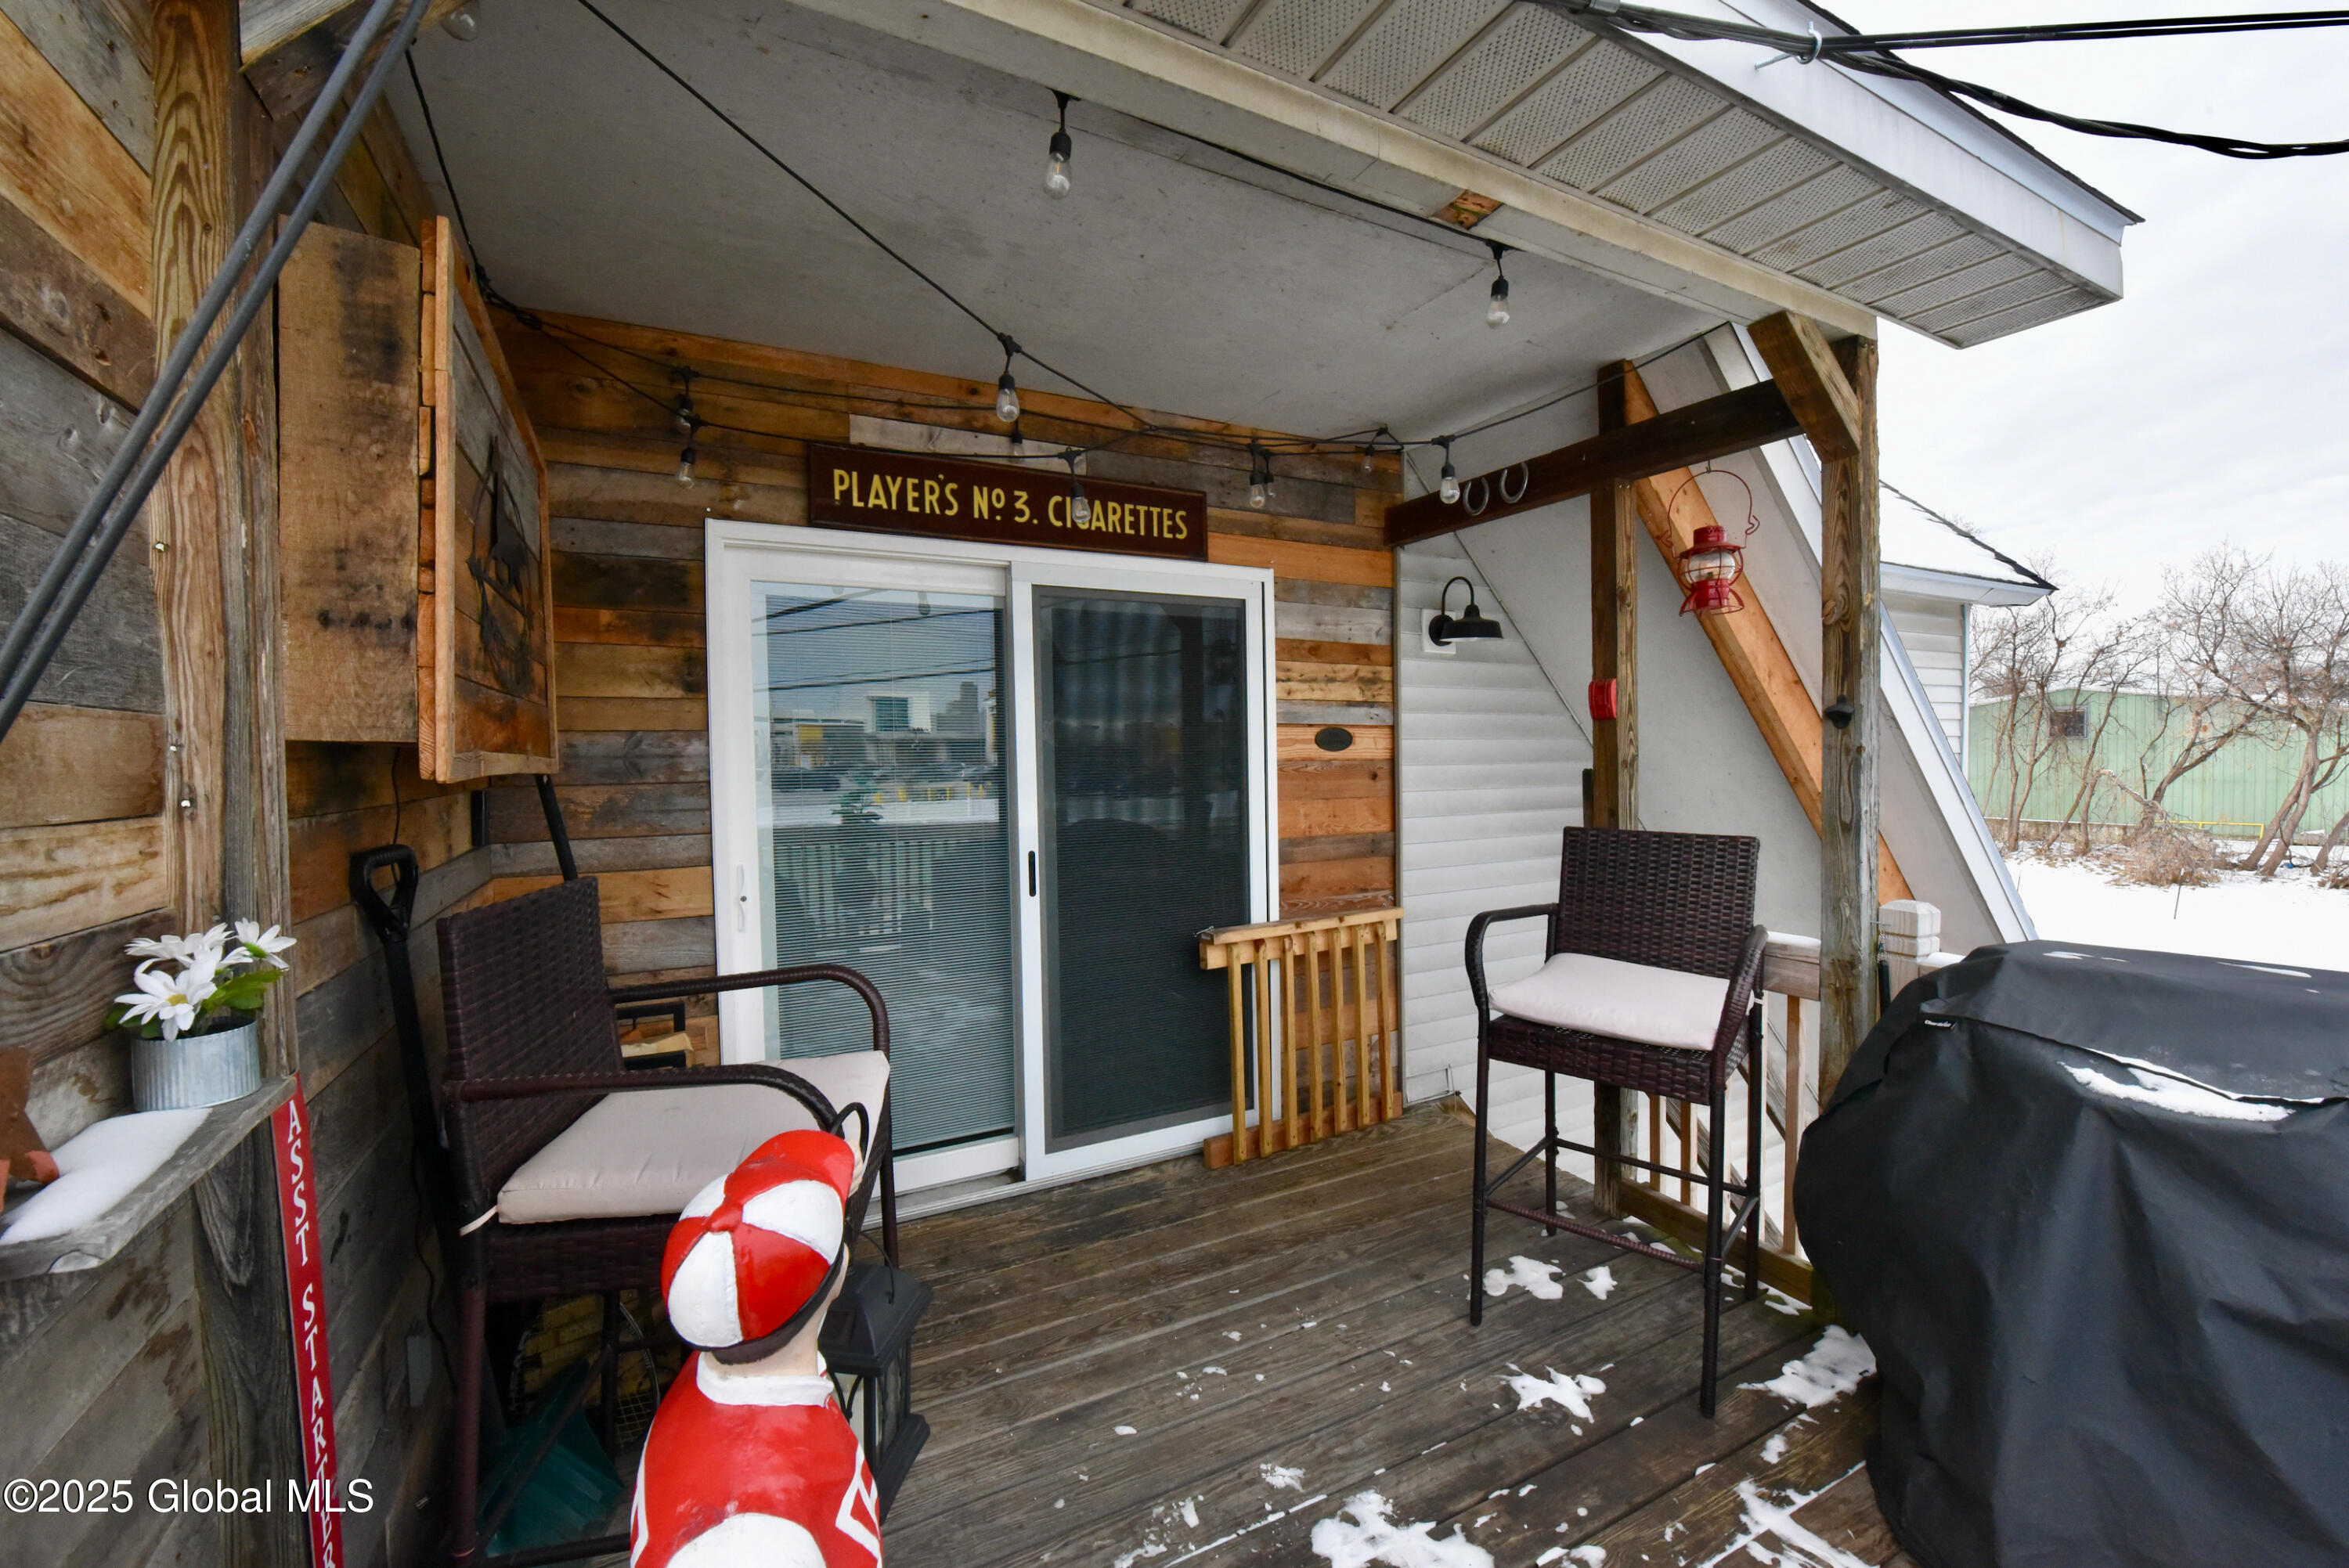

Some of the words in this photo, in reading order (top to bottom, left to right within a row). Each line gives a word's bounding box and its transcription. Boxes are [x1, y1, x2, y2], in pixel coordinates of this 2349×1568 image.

[833, 469, 959, 517] PLAYER'S
[1048, 495, 1189, 540] CIARETTES
[287, 1099, 310, 1267] ASST
